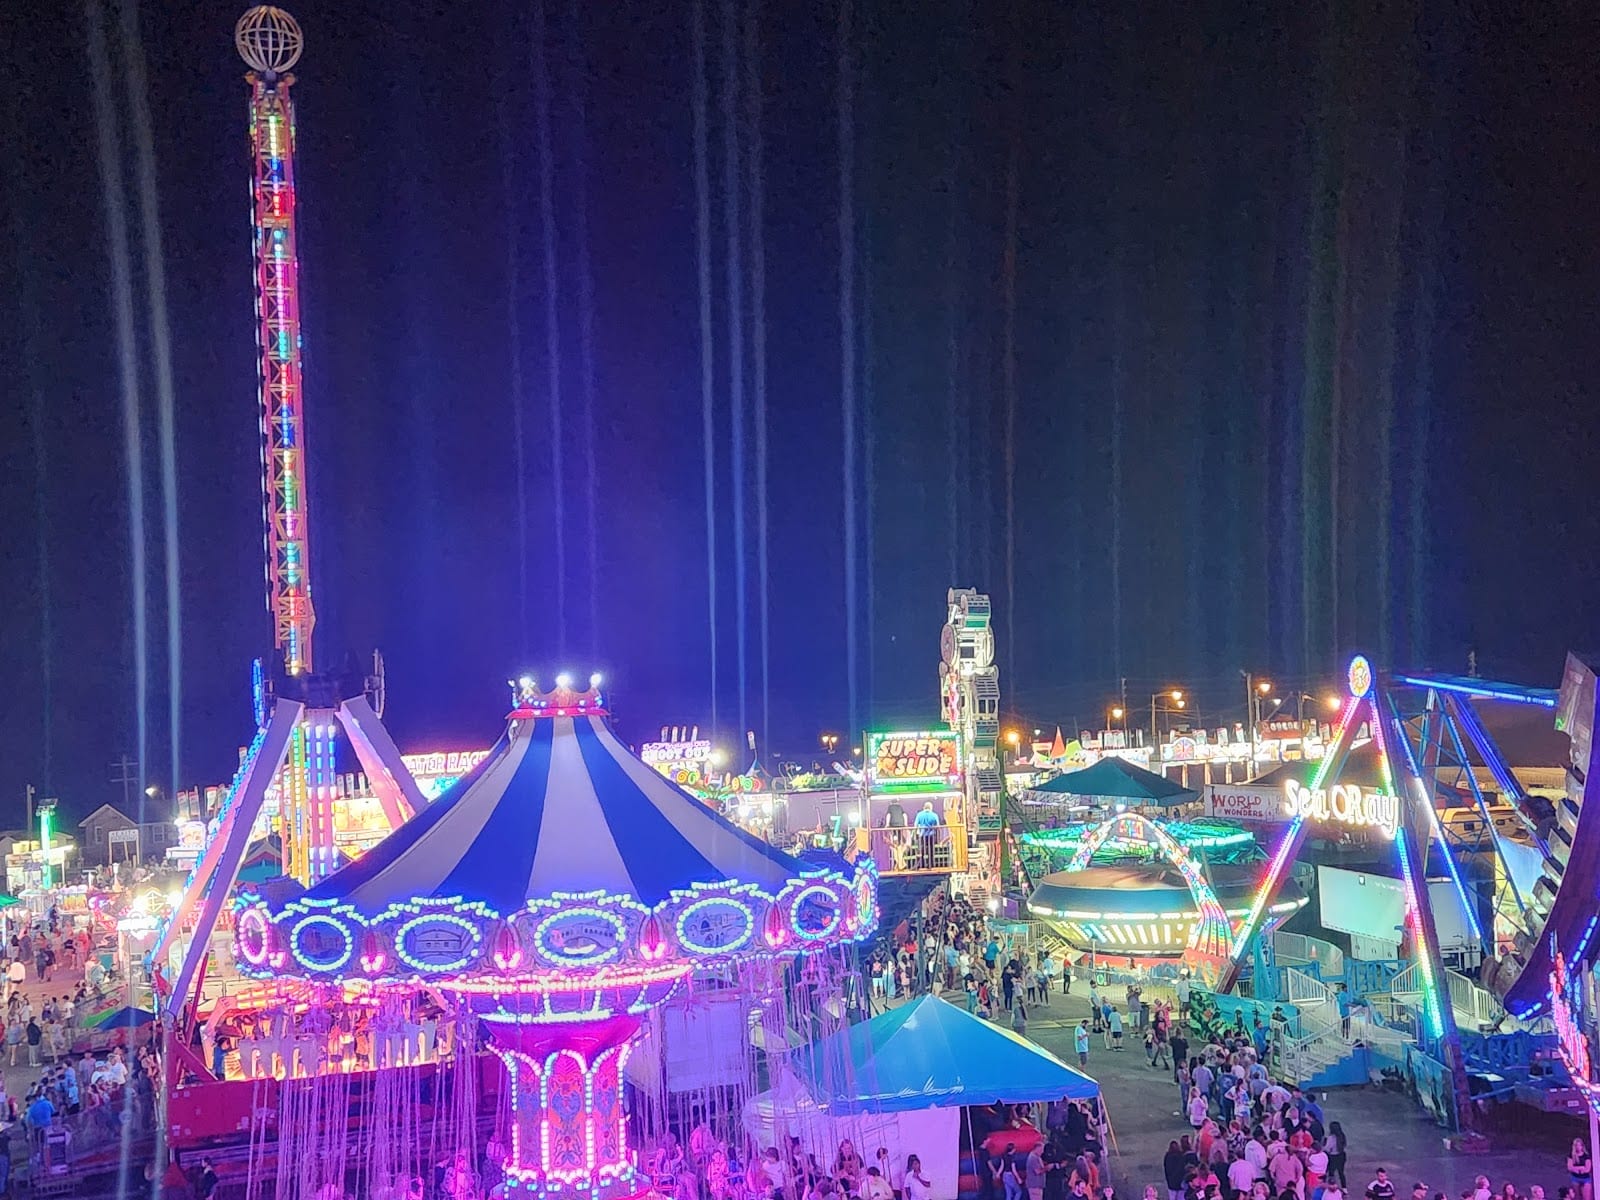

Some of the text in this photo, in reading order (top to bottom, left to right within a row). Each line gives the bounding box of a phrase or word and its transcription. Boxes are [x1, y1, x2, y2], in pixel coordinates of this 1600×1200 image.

[877, 739, 941, 758] SUPER
[402, 753, 445, 775] ATER
[894, 754, 953, 776] SLIDE
[1211, 794, 1262, 808] WORLD
[1284, 778, 1331, 821] Sea
[1223, 808, 1264, 817] WONDERS
